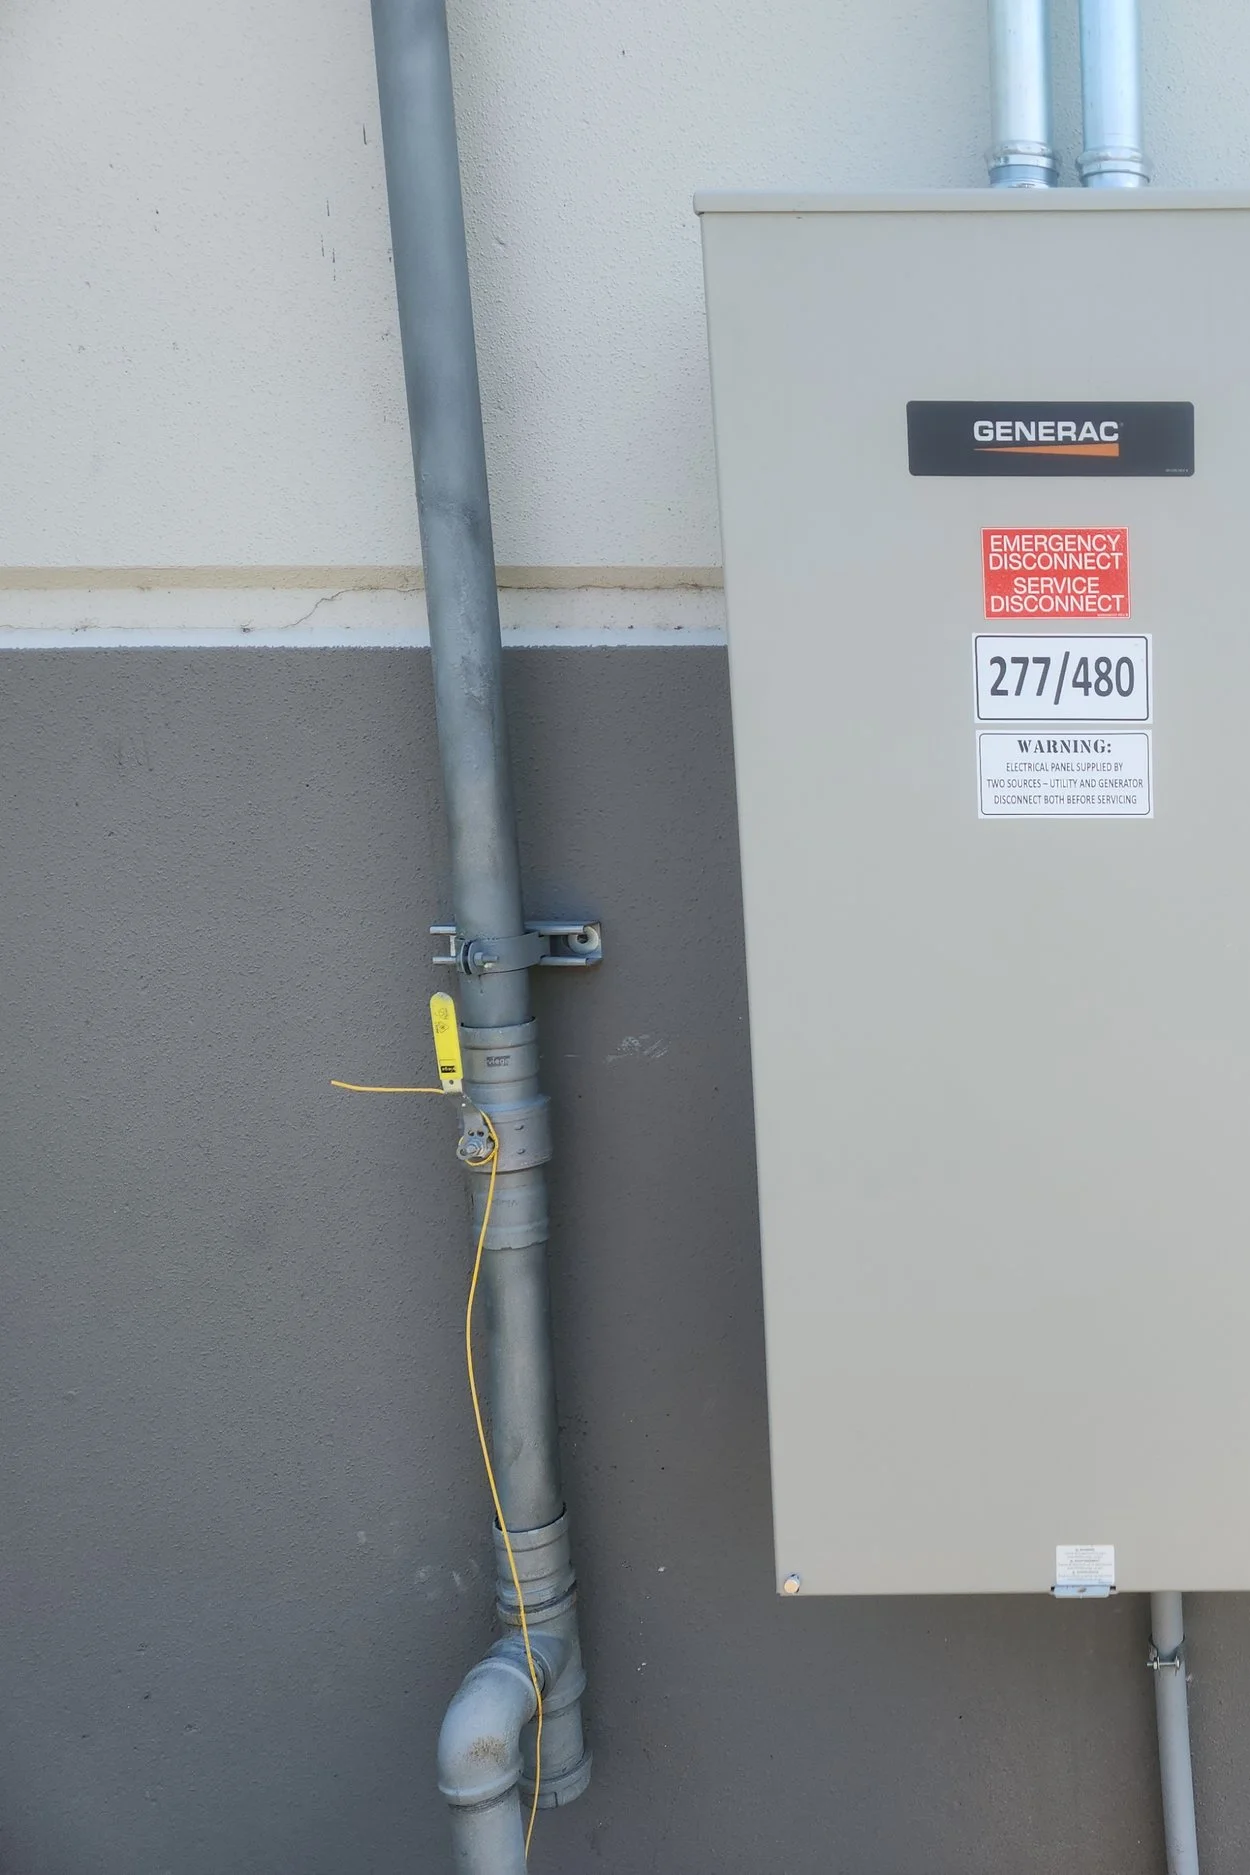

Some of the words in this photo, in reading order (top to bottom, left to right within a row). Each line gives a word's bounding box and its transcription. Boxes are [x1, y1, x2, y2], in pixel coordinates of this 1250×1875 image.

[973, 420, 1119, 442] GENERAC
[990, 534, 1121, 553] EMERGENCY
[988, 552, 1123, 571] DISCONNECT
[1013, 576, 1100, 595] SERVICE
[990, 594, 1125, 613] DISCONNECT
[989, 650, 1135, 706] 277/480
[1017, 739, 1112, 754] WARNING:
[1006, 762, 1049, 773] ELECTRICAL
[1050, 762, 1075, 772] PANEL
[1076, 762, 1113, 772] SUPPLIED
[1113, 762, 1124, 772] BY
[986, 778, 1006, 789] TWO
[1006, 778, 1042, 789] SOURCES
[1049, 778, 1078, 789] UTILITY
[1079, 778, 1097, 789] AND
[1098, 778, 1144, 789] GENERATOR
[993, 794, 1042, 805] DISCONNECT
[1043, 794, 1065, 805] BOTH
[1066, 794, 1096, 805] BEFORE
[1097, 794, 1137, 805] SERVICING
